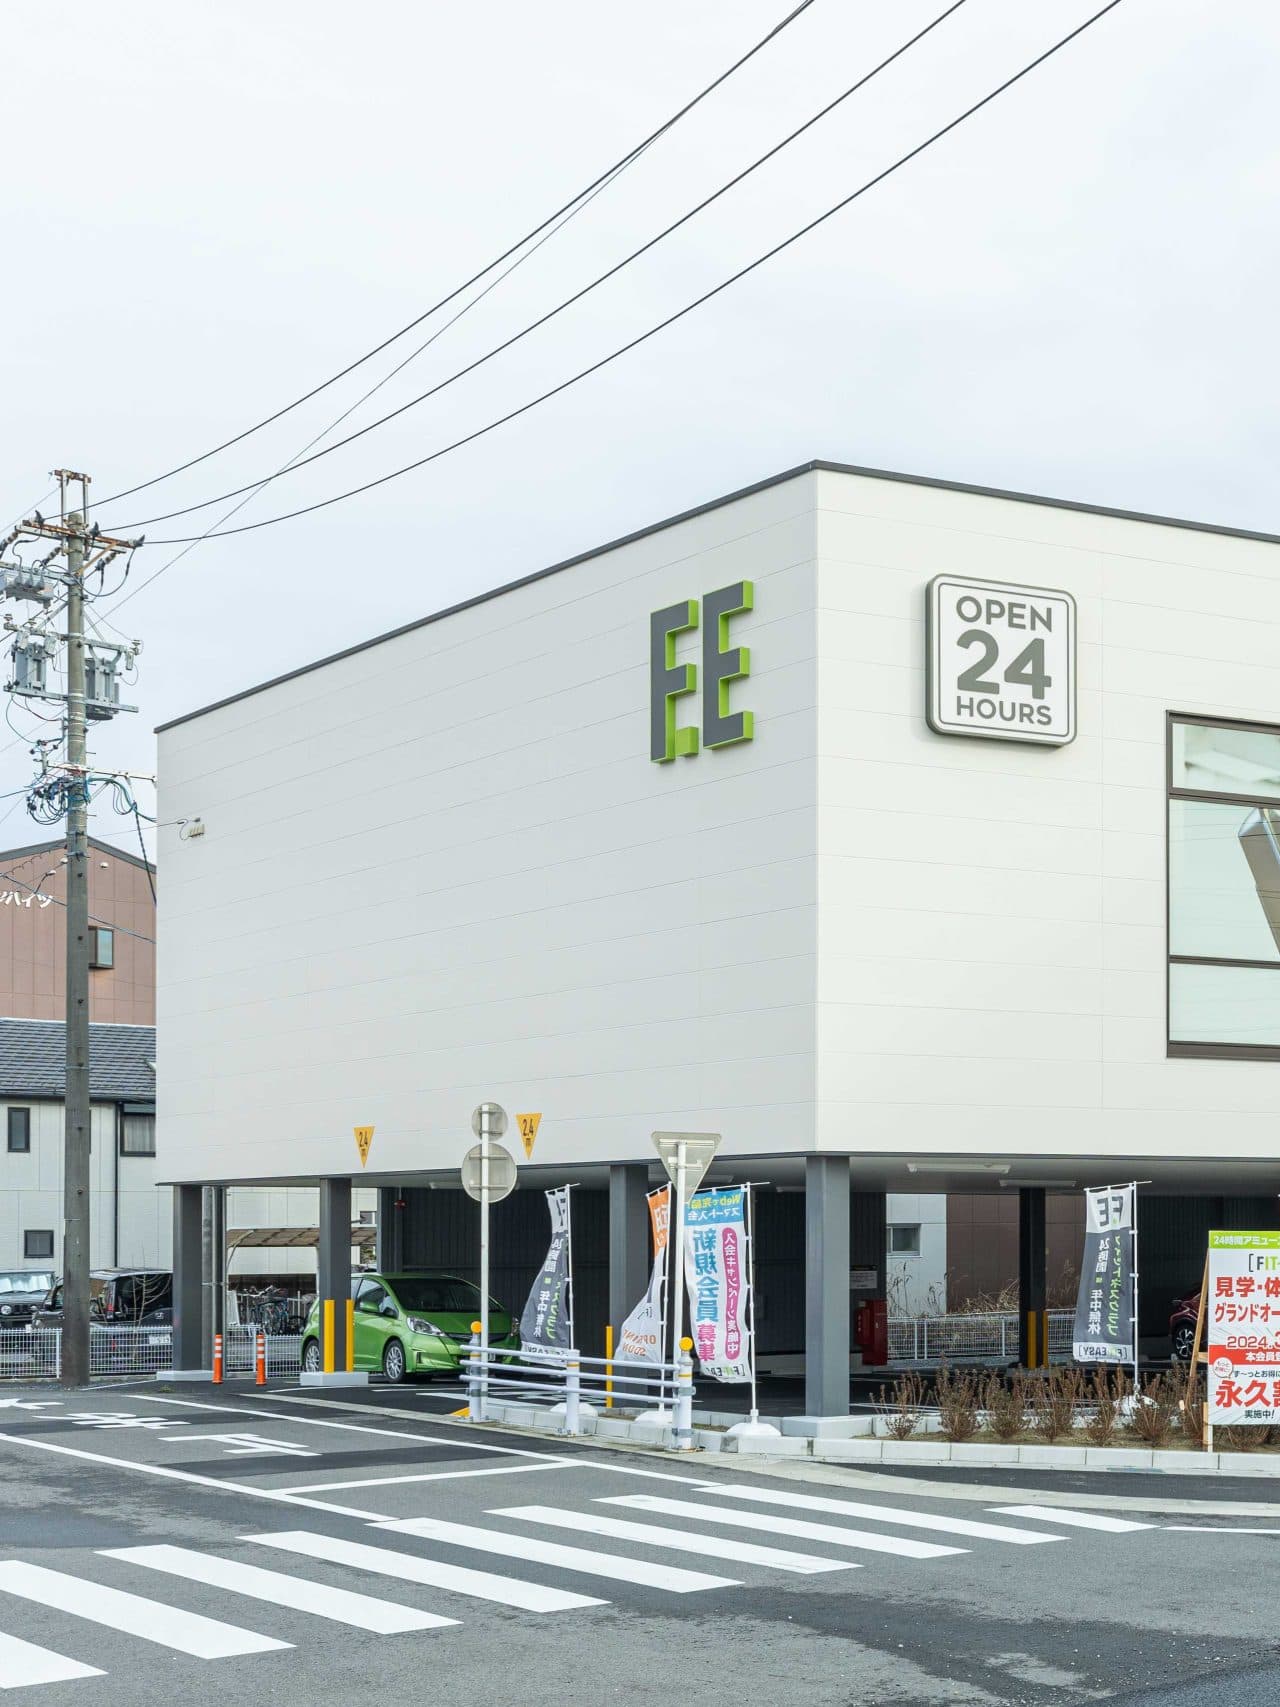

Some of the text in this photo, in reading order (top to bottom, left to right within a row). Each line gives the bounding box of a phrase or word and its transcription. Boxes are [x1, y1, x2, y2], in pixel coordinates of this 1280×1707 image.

[956, 595, 1053, 632] OPEN
[956, 629, 1052, 700] 24
[956, 695, 1052, 726] HOURS
